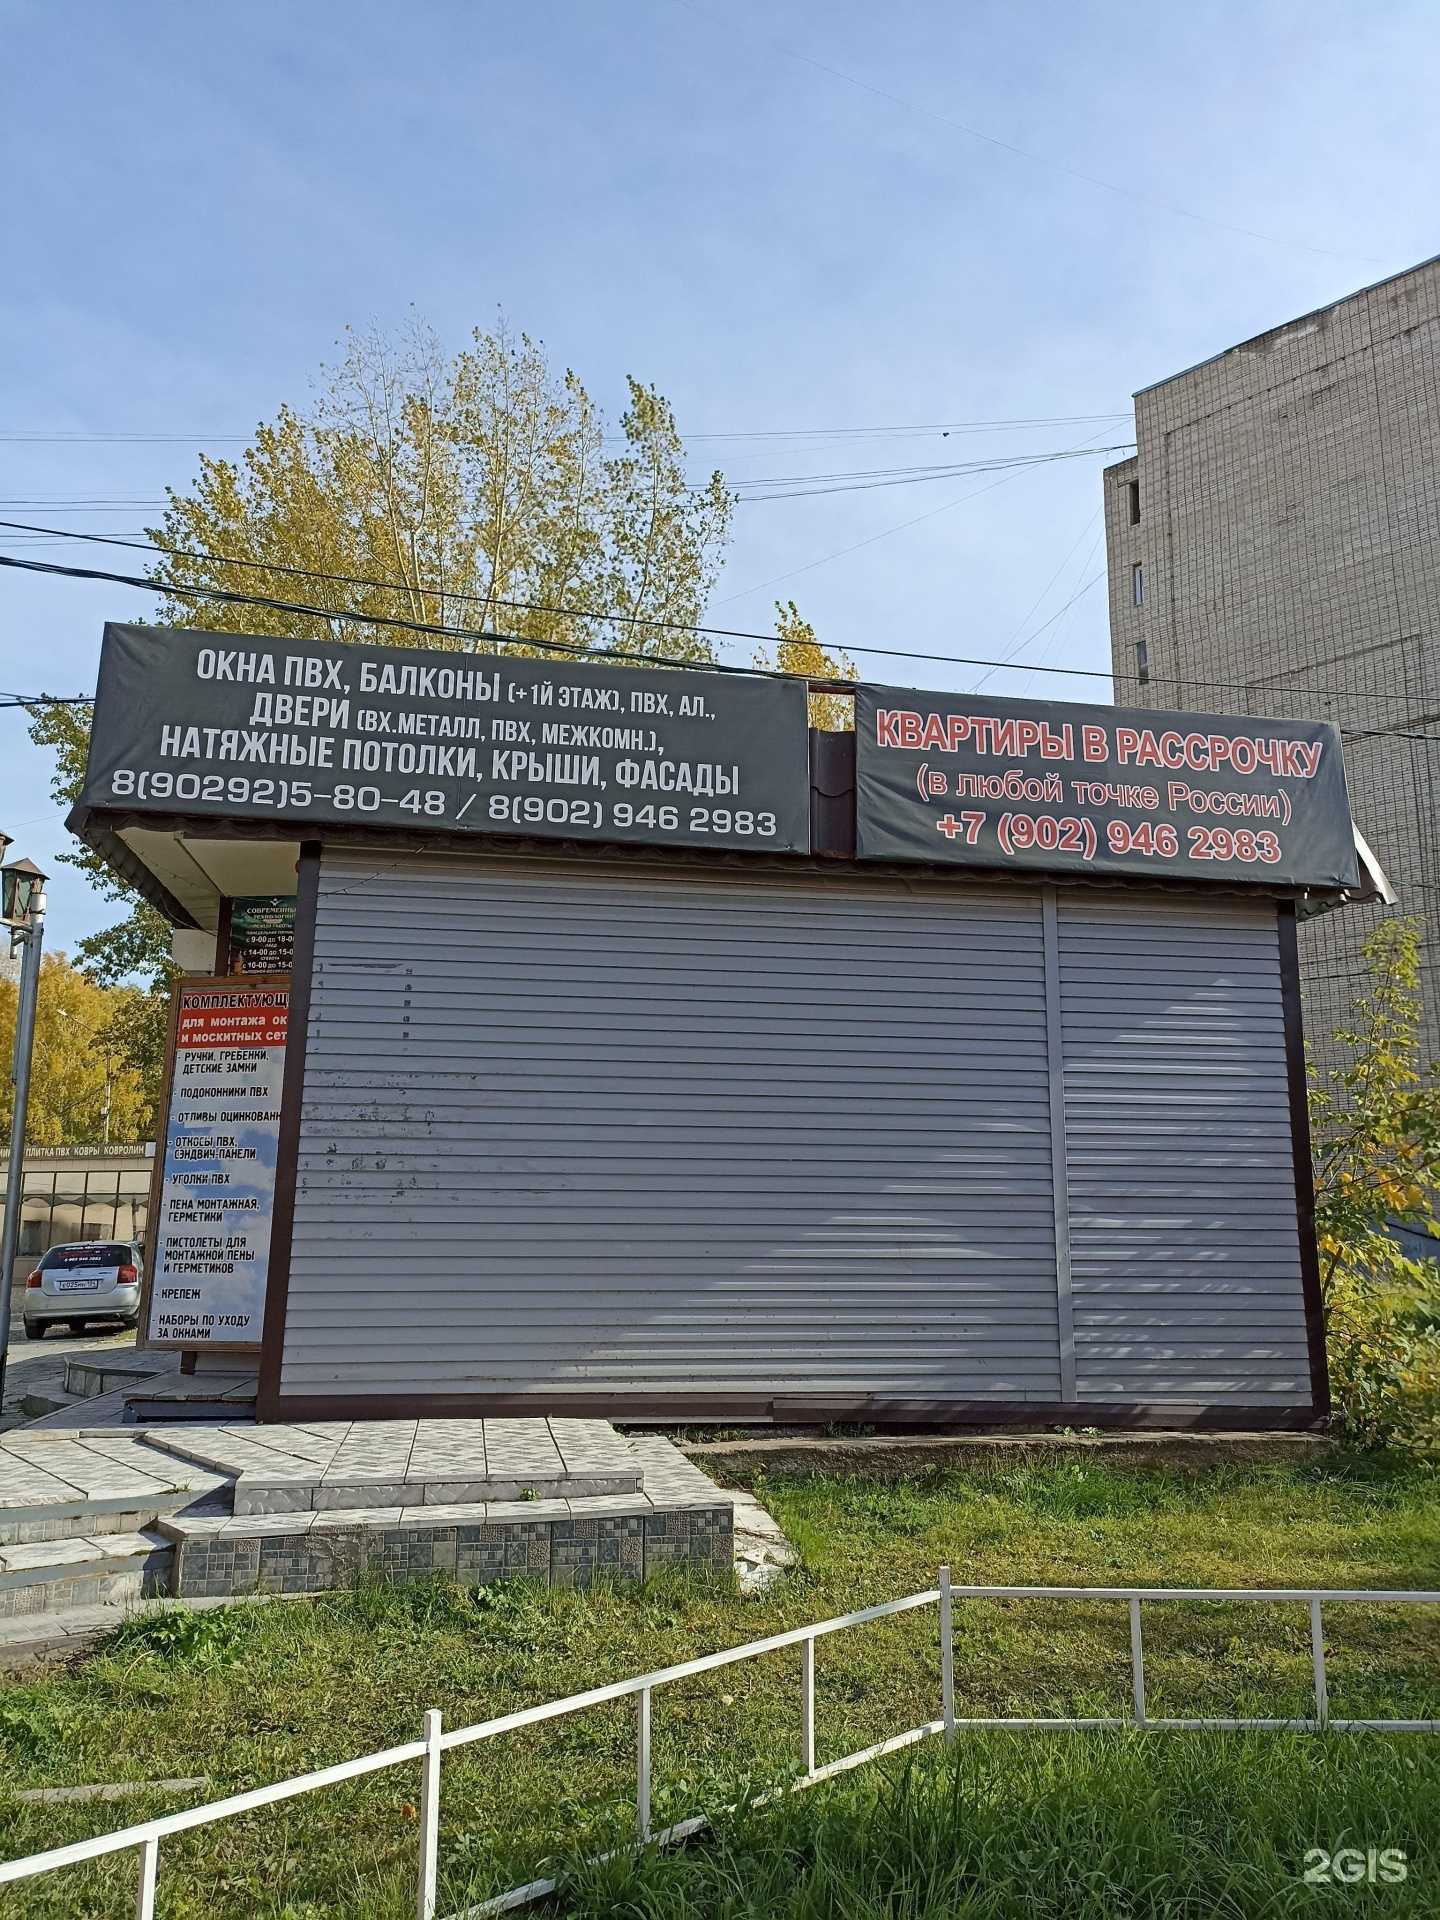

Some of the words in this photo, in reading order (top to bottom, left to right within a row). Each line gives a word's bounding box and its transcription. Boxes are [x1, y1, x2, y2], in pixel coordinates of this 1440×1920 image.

[197, 649, 275, 684] ОКНА
[284, 655, 350, 694] ПВХ,
[359, 662, 500, 702] БАЛКОНЫ
[558, 687, 625, 713] ЭТАЖ),
[630, 691, 674, 716] ПВХ,
[679, 695, 716, 721] АЛ.,
[249, 692, 350, 730] ДВЕРИ
[491, 719, 536, 746] ПВХ,
[542, 723, 665, 756] МЕЖКОМН.),
[876, 709, 1074, 761] КВАРТИРЫ
[1082, 724, 1110, 764] В
[1117, 727, 1323, 779] РАССРОЧКУ
[160, 725, 334, 769] НАТЯЖНЫЕ
[342, 739, 483, 783] ПОТОЛКИ,
[491, 749, 607, 791] КРЫШИ,
[615, 758, 740, 797] ФАСАДЫ
[916, 763, 948, 802] (в
[955, 769, 1063, 805] любой
[1070, 780, 1159, 811] точке
[1168, 780, 1293, 826] России)
[111, 769, 446, 816] 8(90292)5-80-48
[488, 794, 603, 829] 8(902)
[612, 803, 679, 831] 946
[689, 807, 777, 837] 2983
[936, 810, 987, 845] +7
[997, 813, 1098, 861] (902)
[1107, 820, 1180, 858] 946
[1188, 826, 1282, 864] 2983
[182, 993, 289, 1010] КОМПЛЕКТУЮЩ
[182, 1018, 204, 1029] для
[210, 1016, 266, 1027] монтажа
[272, 1016, 288, 1025] ок
[181, 1034, 189, 1043] и
[192, 1032, 262, 1042] москитных
[266, 1031, 288, 1041] сет
[182, 1063, 223, 1075] ДЕТСКИЕ
[226, 1062, 257, 1073] ЗАМКИ
[180, 1087, 247, 1099] ПОДОКОННИКИ
[249, 1087, 269, 1097] ПВХ
[178, 1112, 218, 1122] ОТЛИВЫ
[220, 1111, 280, 1123] ОЦИНКОВАНН
[175, 1137, 213, 1147] ОТКОСЫ
[55, 1147, 70, 1156] ПВХ
[74, 1146, 100, 1156] КОВРЫ
[104, 1145, 144, 1155] КОВРОЛИН
[174, 1148, 256, 1160] СЭНДВИЧ-ПАНЕЛИ
[172, 1174, 208, 1184] УГОЛКИ
[212, 1174, 230, 1184] ПВХ
[170, 1200, 194, 1210] ПЕНА
[168, 1212, 223, 1222] ГЕРМЕТИКИ
[166, 1238, 222, 1248] ПИСТОЛЕТЫ
[226, 1237, 247, 1249] ДЛЯ
[164, 1249, 224, 1260] МОНТАЖНОЙ
[227, 1250, 255, 1260] ПЕНЫ
[163, 1263, 170, 1273] И
[173, 1263, 234, 1274] ГЕРМЕТИКОВ
[161, 1288, 201, 1299] КРЕПЕЖ
[158, 1314, 199, 1326] НАБОРЫ
[202, 1315, 215, 1326] ПО
[218, 1315, 250, 1327] УХОДУ
[158, 1328, 168, 1338] ЗА
[172, 1328, 211, 1338] ОКНАМИ
